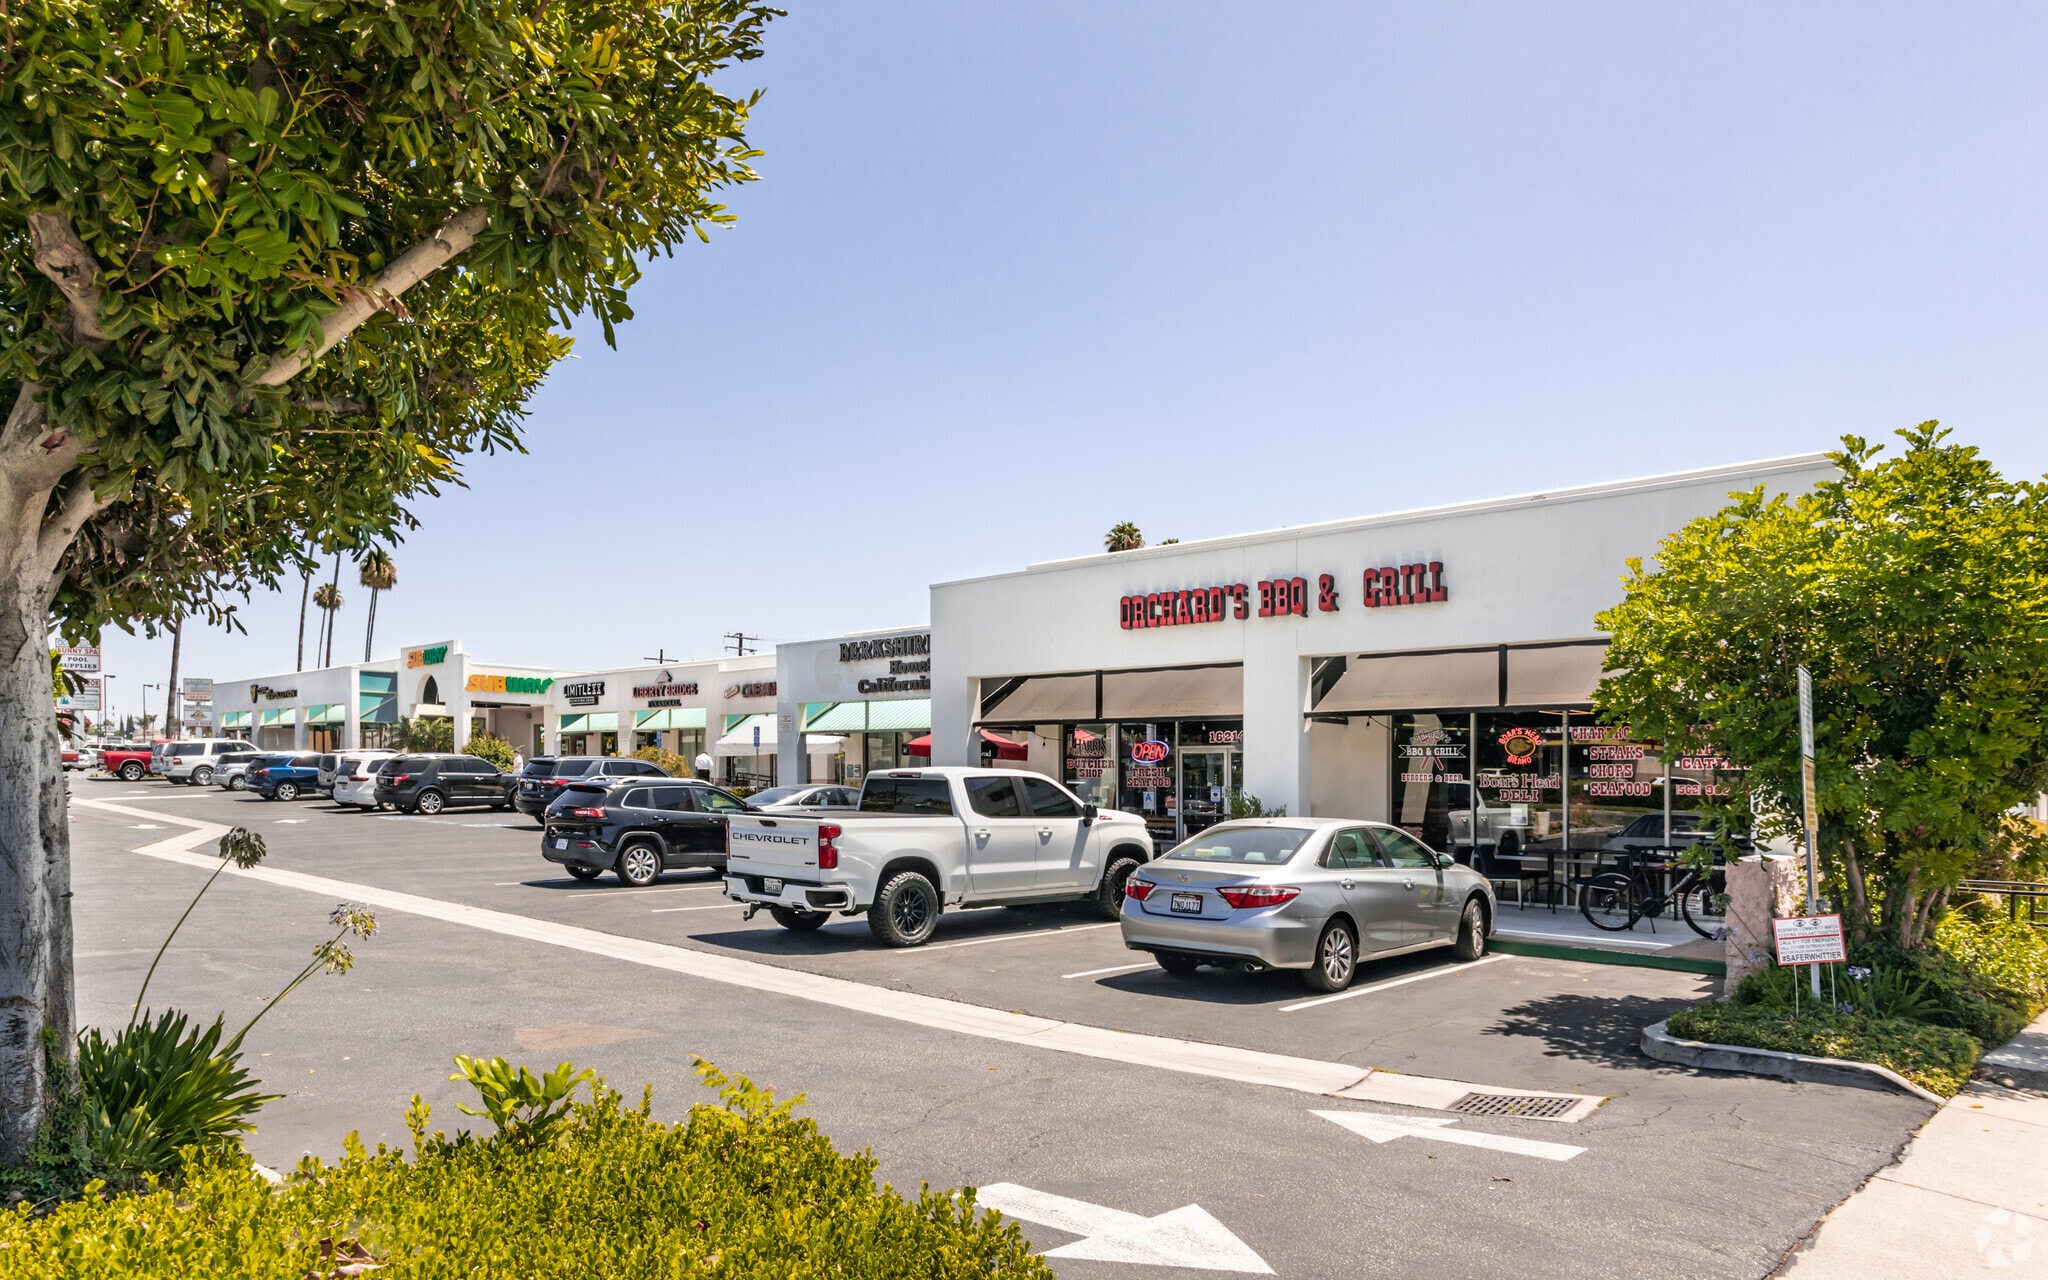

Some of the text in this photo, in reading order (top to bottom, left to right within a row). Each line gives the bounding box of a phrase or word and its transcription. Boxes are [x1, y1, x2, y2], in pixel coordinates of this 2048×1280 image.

[1120, 561, 1448, 630] ORCHARD'S BBQ & GRILL
[407, 645, 448, 669] SUBWAY
[464, 674, 553, 694] SUBWAY
[564, 682, 604, 698] LIMITLESS
[632, 683, 698, 698] LIBERTY BRIDGE
[1498, 727, 1543, 746] BOAR'S HEAD
[1132, 742, 1166, 760] OPEN
[1406, 747, 1459, 756] BBQ & GRILL
[1589, 746, 1644, 760] STEAKS
[1067, 759, 1115, 768] BUTCHER
[1507, 756, 1532, 765] BRAND
[1079, 769, 1103, 778] SHOP
[1132, 768, 1165, 777] FRESH
[1589, 764, 1633, 777] CHOPS
[1127, 777, 1171, 787] SEAFOOD
[1401, 773, 1433, 782] BURGERS
[1444, 773, 1463, 782] BEER
[1479, 773, 1560, 788] Boar's Head
[1499, 789, 1539, 802] DELI
[1590, 782, 1651, 796] SEAFOOD
[1145, 793, 1152, 802] A
[732, 833, 809, 845] CHEVROLET
[1782, 951, 1842, 962] #SAFERWHITTIER
